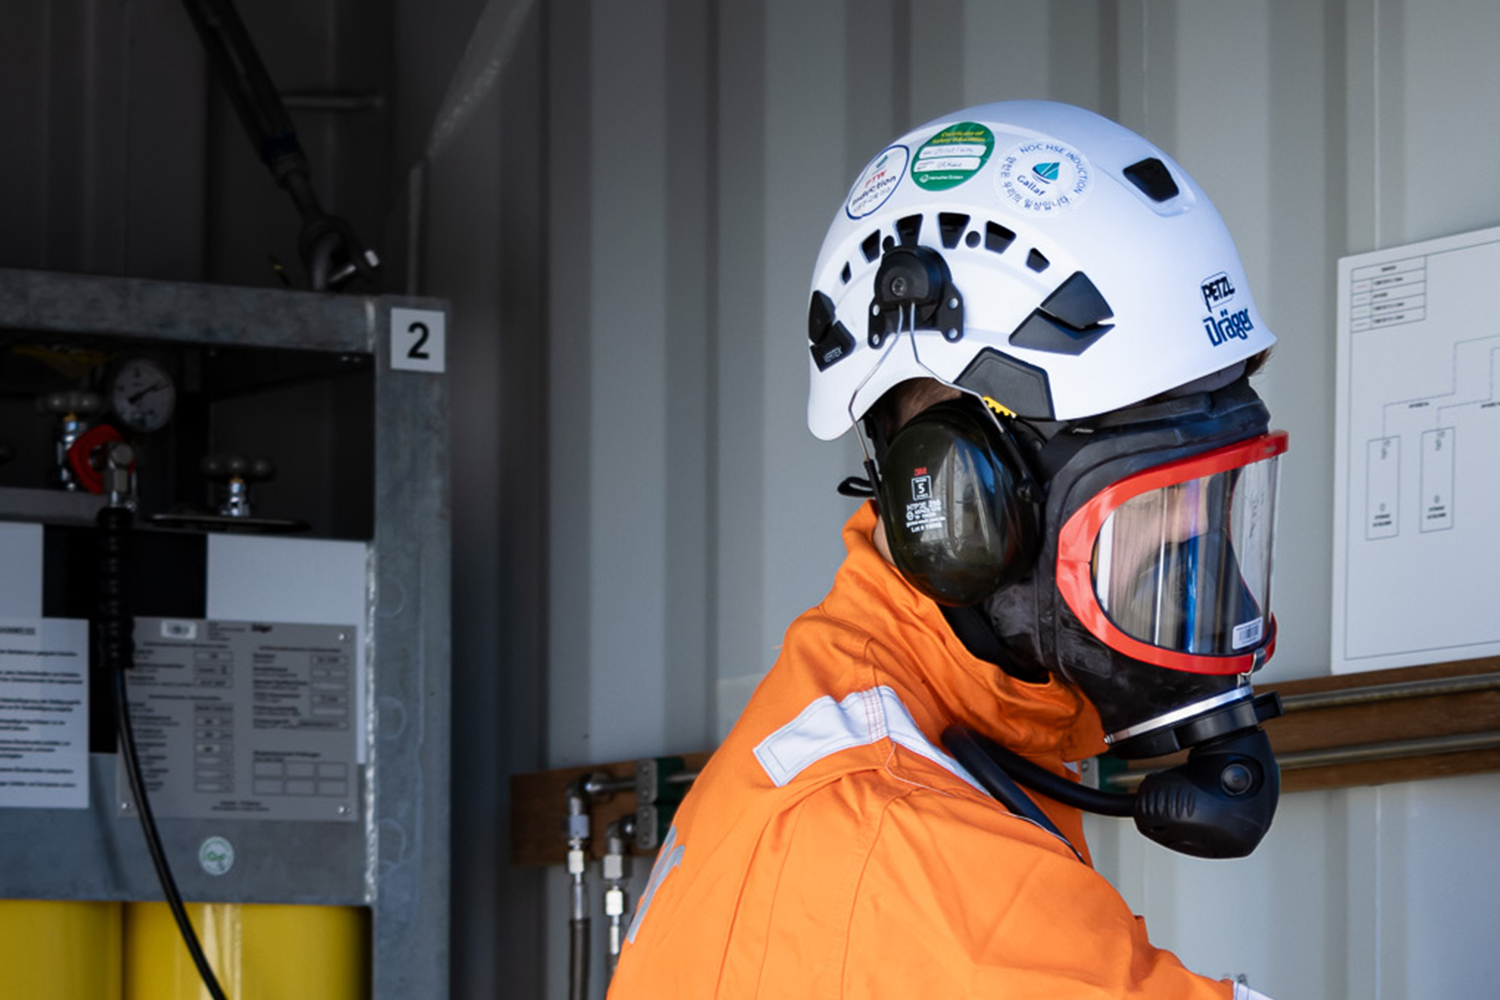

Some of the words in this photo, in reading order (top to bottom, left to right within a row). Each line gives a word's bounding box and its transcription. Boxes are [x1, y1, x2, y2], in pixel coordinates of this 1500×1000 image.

[1045, 144, 1066, 154] HSE
[1065, 152, 1088, 195] INDUCTION
[1201, 276, 1236, 313] PETZL
[408, 322, 430, 360] 2
[1203, 309, 1254, 347] Dräger
[918, 483, 925, 493] 5
